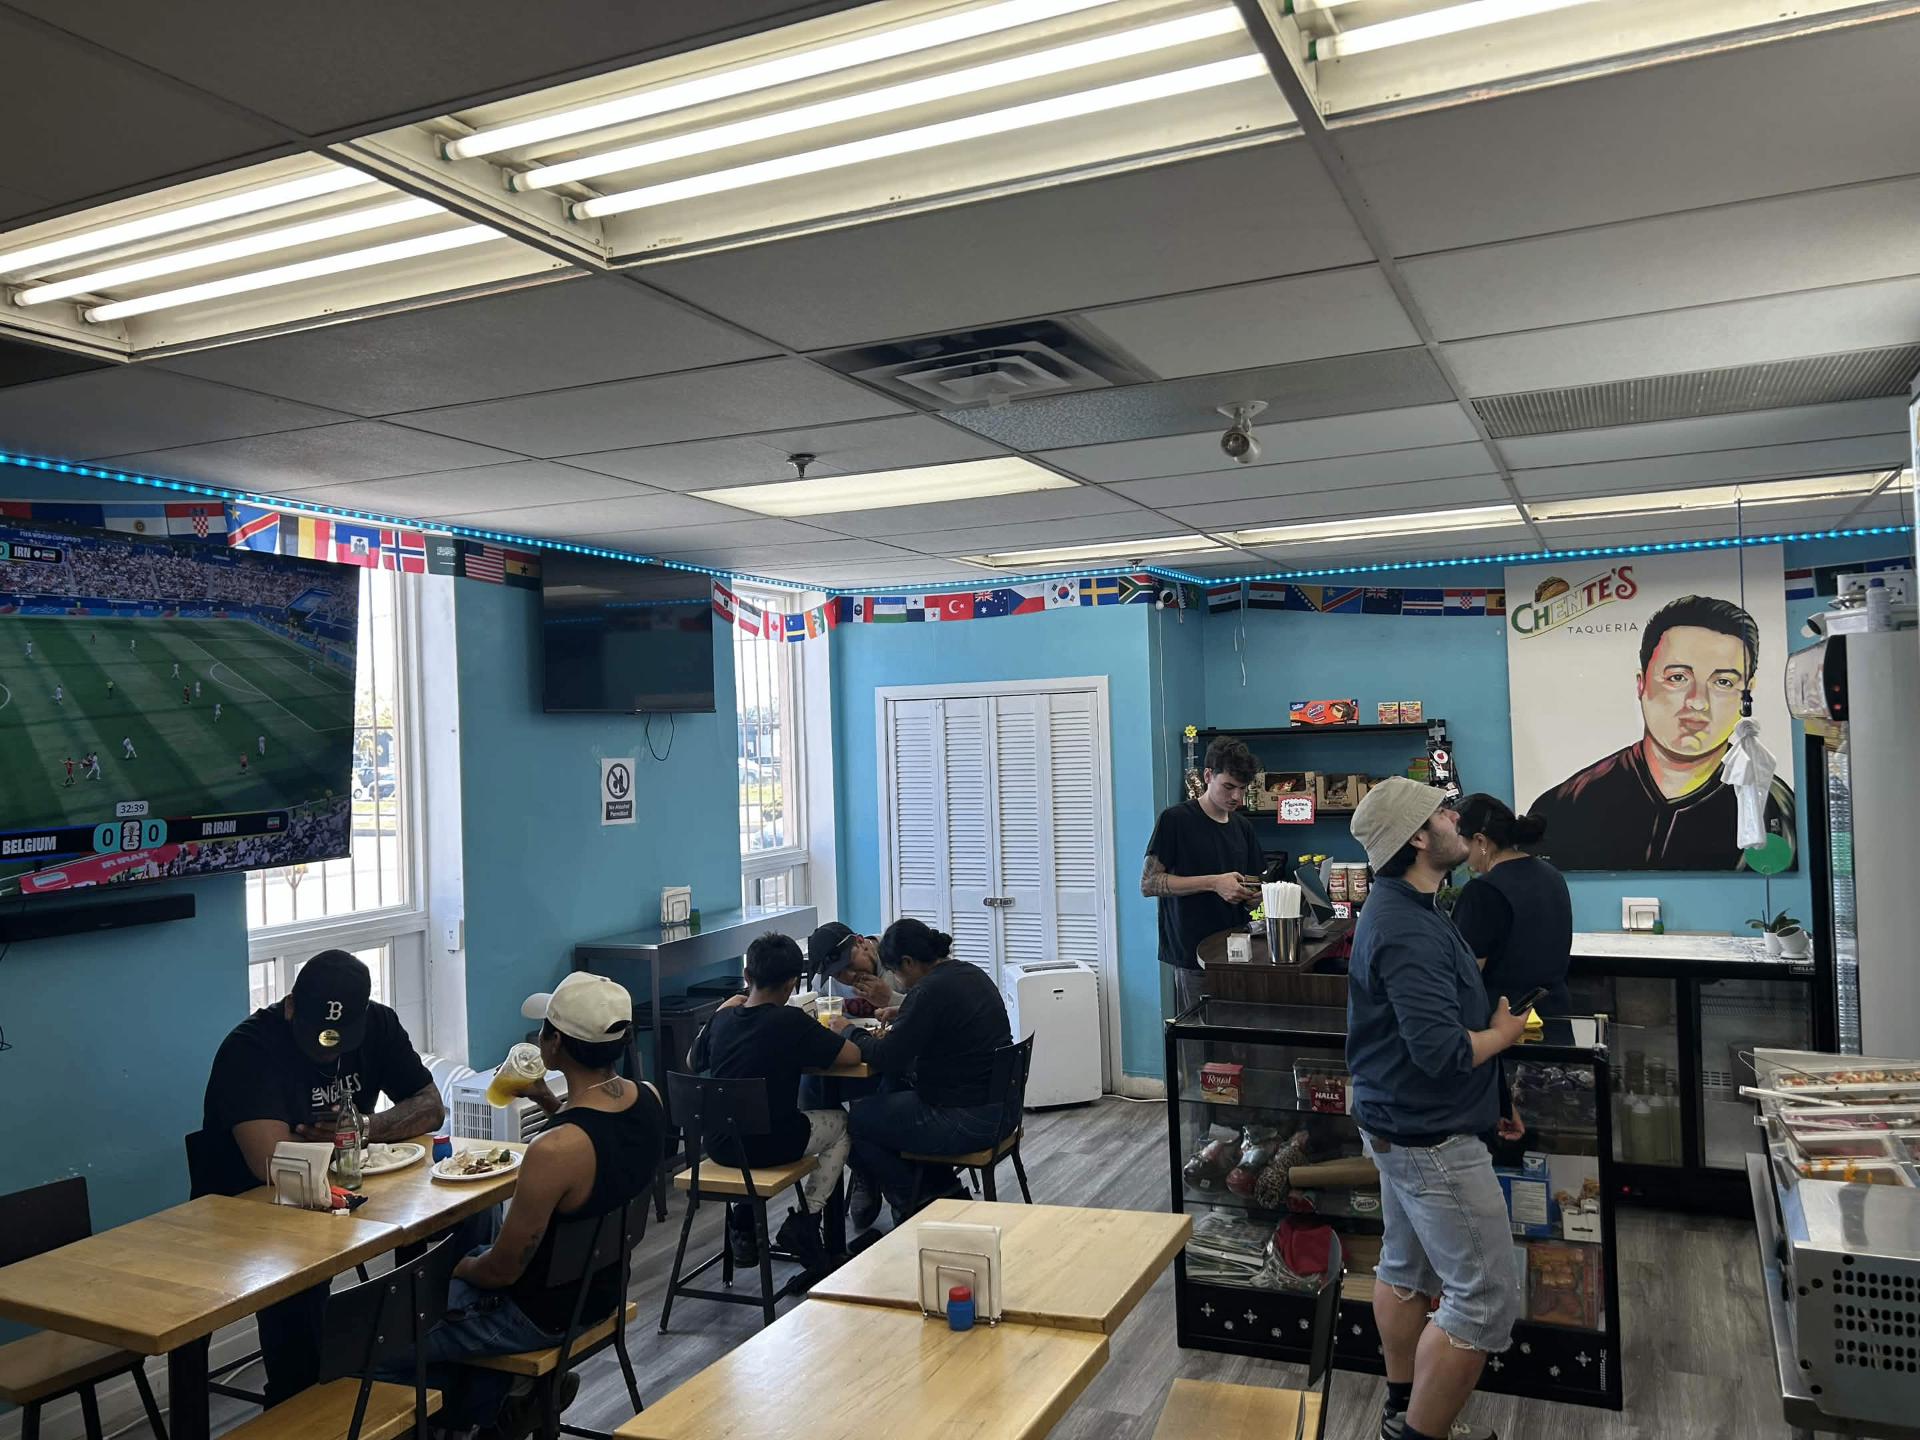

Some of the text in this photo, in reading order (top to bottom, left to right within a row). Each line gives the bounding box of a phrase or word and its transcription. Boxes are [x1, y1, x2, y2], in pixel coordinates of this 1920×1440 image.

[14, 546, 31, 558] IRN
[1511, 565, 1638, 634] CHENTE'S
[1567, 622, 1638, 634] TAQUERIA
[120, 804, 145, 814] 32:39
[2, 836, 57, 855] BELGIUM
[102, 828, 114, 846] 0
[148, 824, 160, 843] 0
[202, 822, 212, 836] IR
[213, 820, 237, 834] IRAN
[117, 852, 149, 865] IRAN
[325, 1001, 342, 1020] B
[1206, 1074, 1231, 1085] Royal
[1315, 1091, 1340, 1100] HALLS
